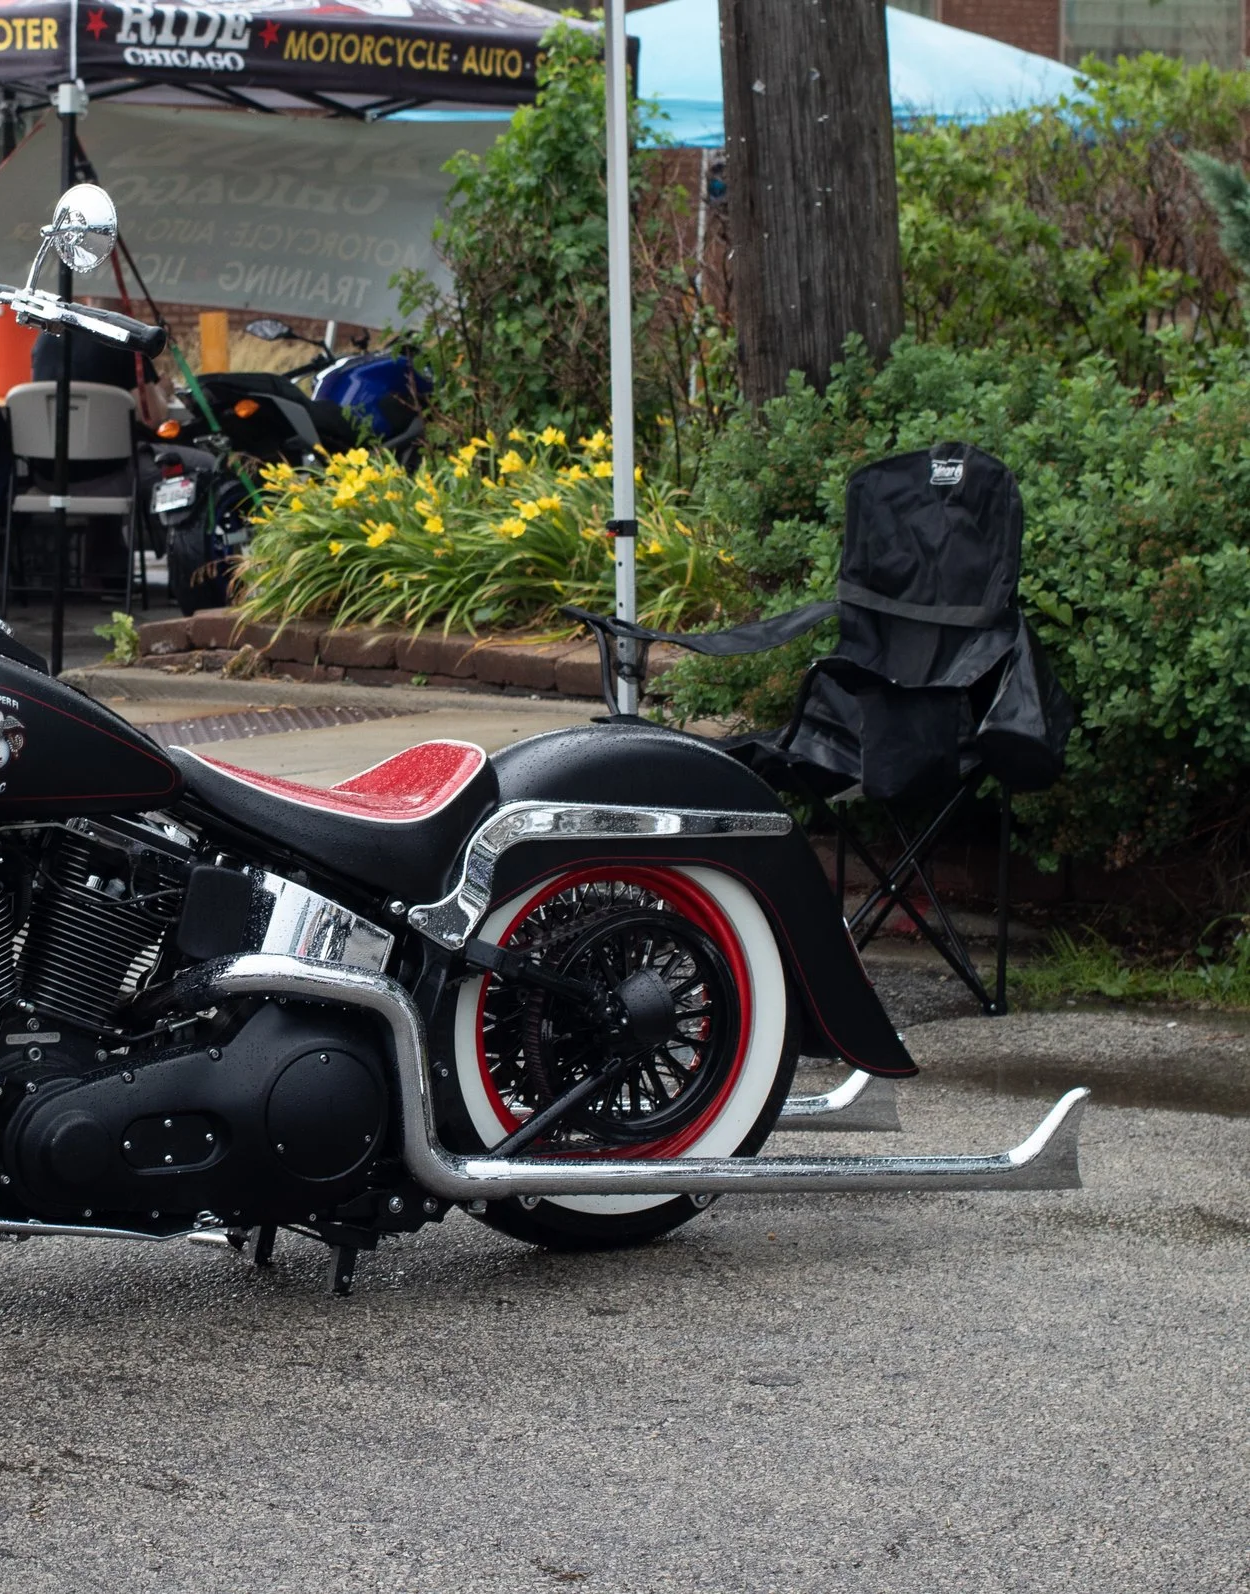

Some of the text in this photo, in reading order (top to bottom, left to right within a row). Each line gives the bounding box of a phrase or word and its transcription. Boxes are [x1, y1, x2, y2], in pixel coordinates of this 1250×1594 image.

[114, 4, 253, 50] RIDE
[124, 47, 245, 72] CHICAGO
[284, 30, 451, 72] MOTORCYCLE
[462, 46, 522, 79] AUTO
[11, 699, 20, 710] FI
